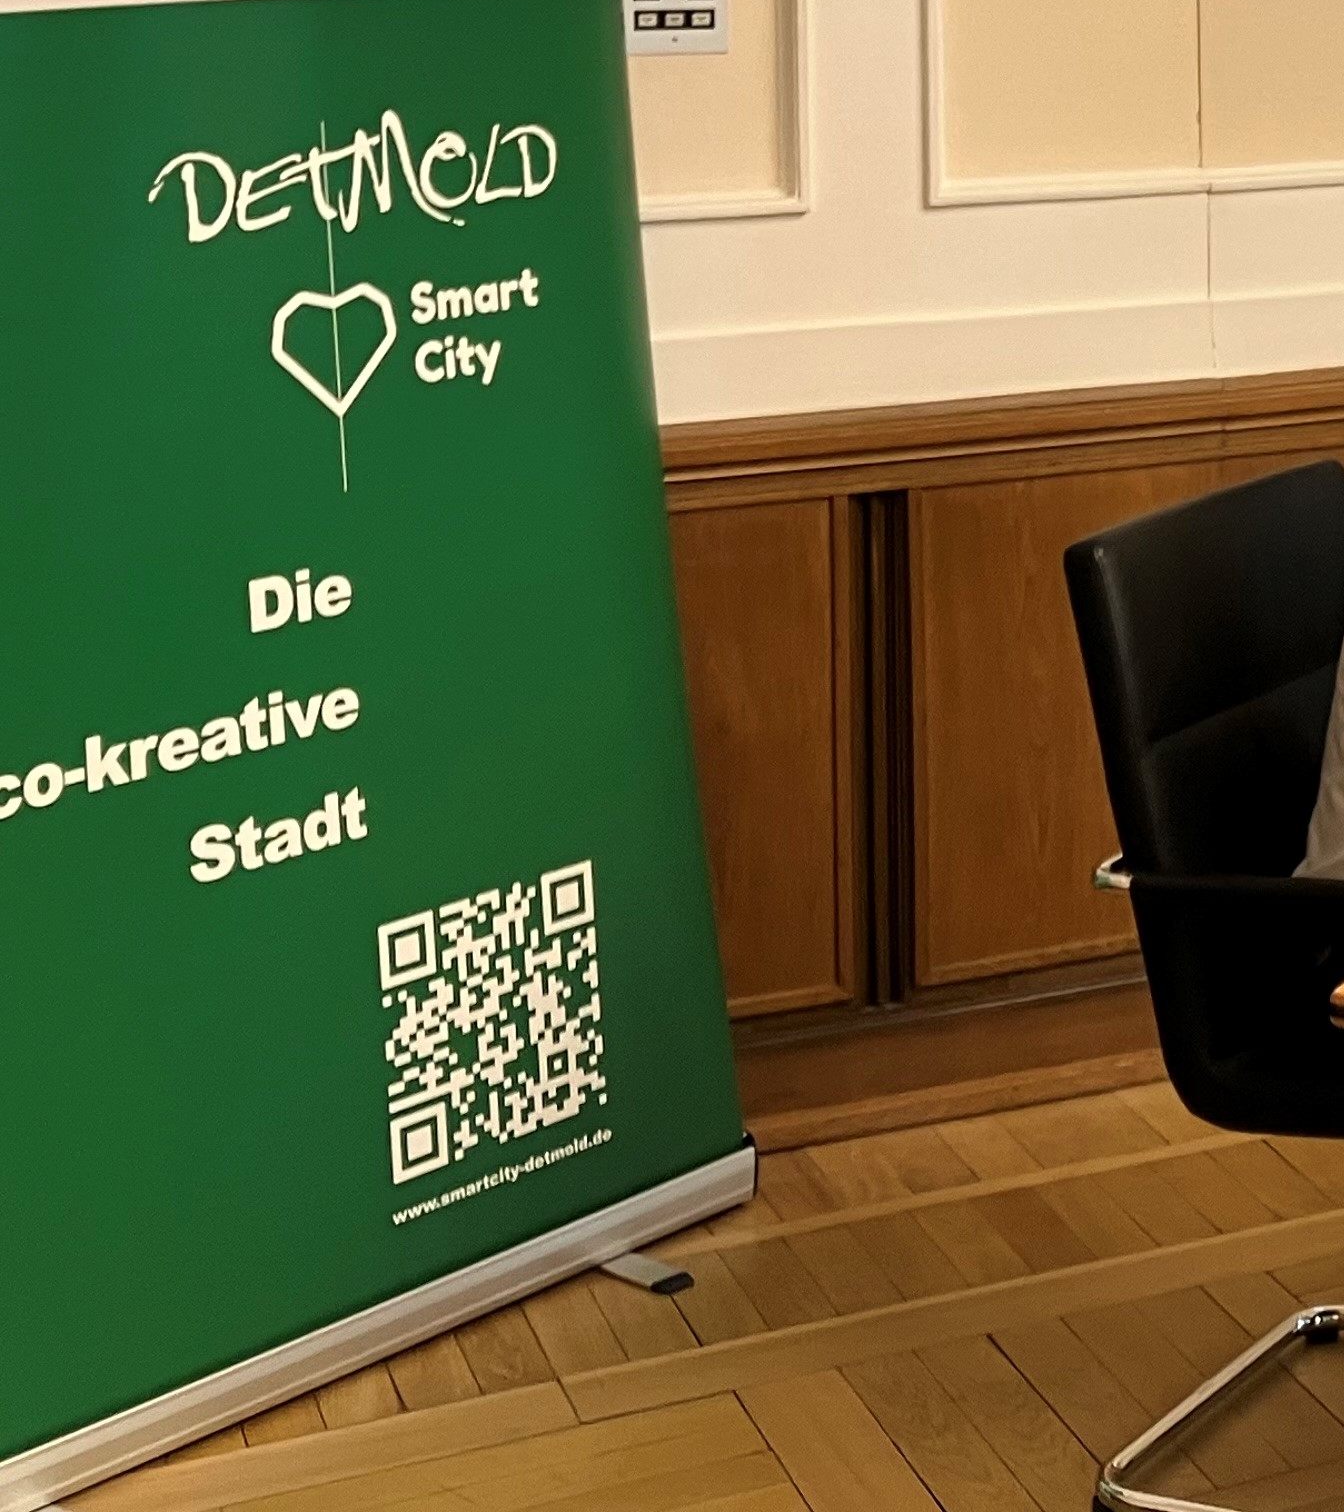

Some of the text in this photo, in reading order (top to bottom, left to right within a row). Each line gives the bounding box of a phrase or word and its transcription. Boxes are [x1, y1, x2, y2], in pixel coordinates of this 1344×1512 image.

[411, 268, 539, 324] Smart
[415, 336, 501, 386] City
[248, 568, 352, 634] Die
[190, 786, 368, 883] Stadt
[392, 1128, 613, 1226] www.smartcity-detmold.de
